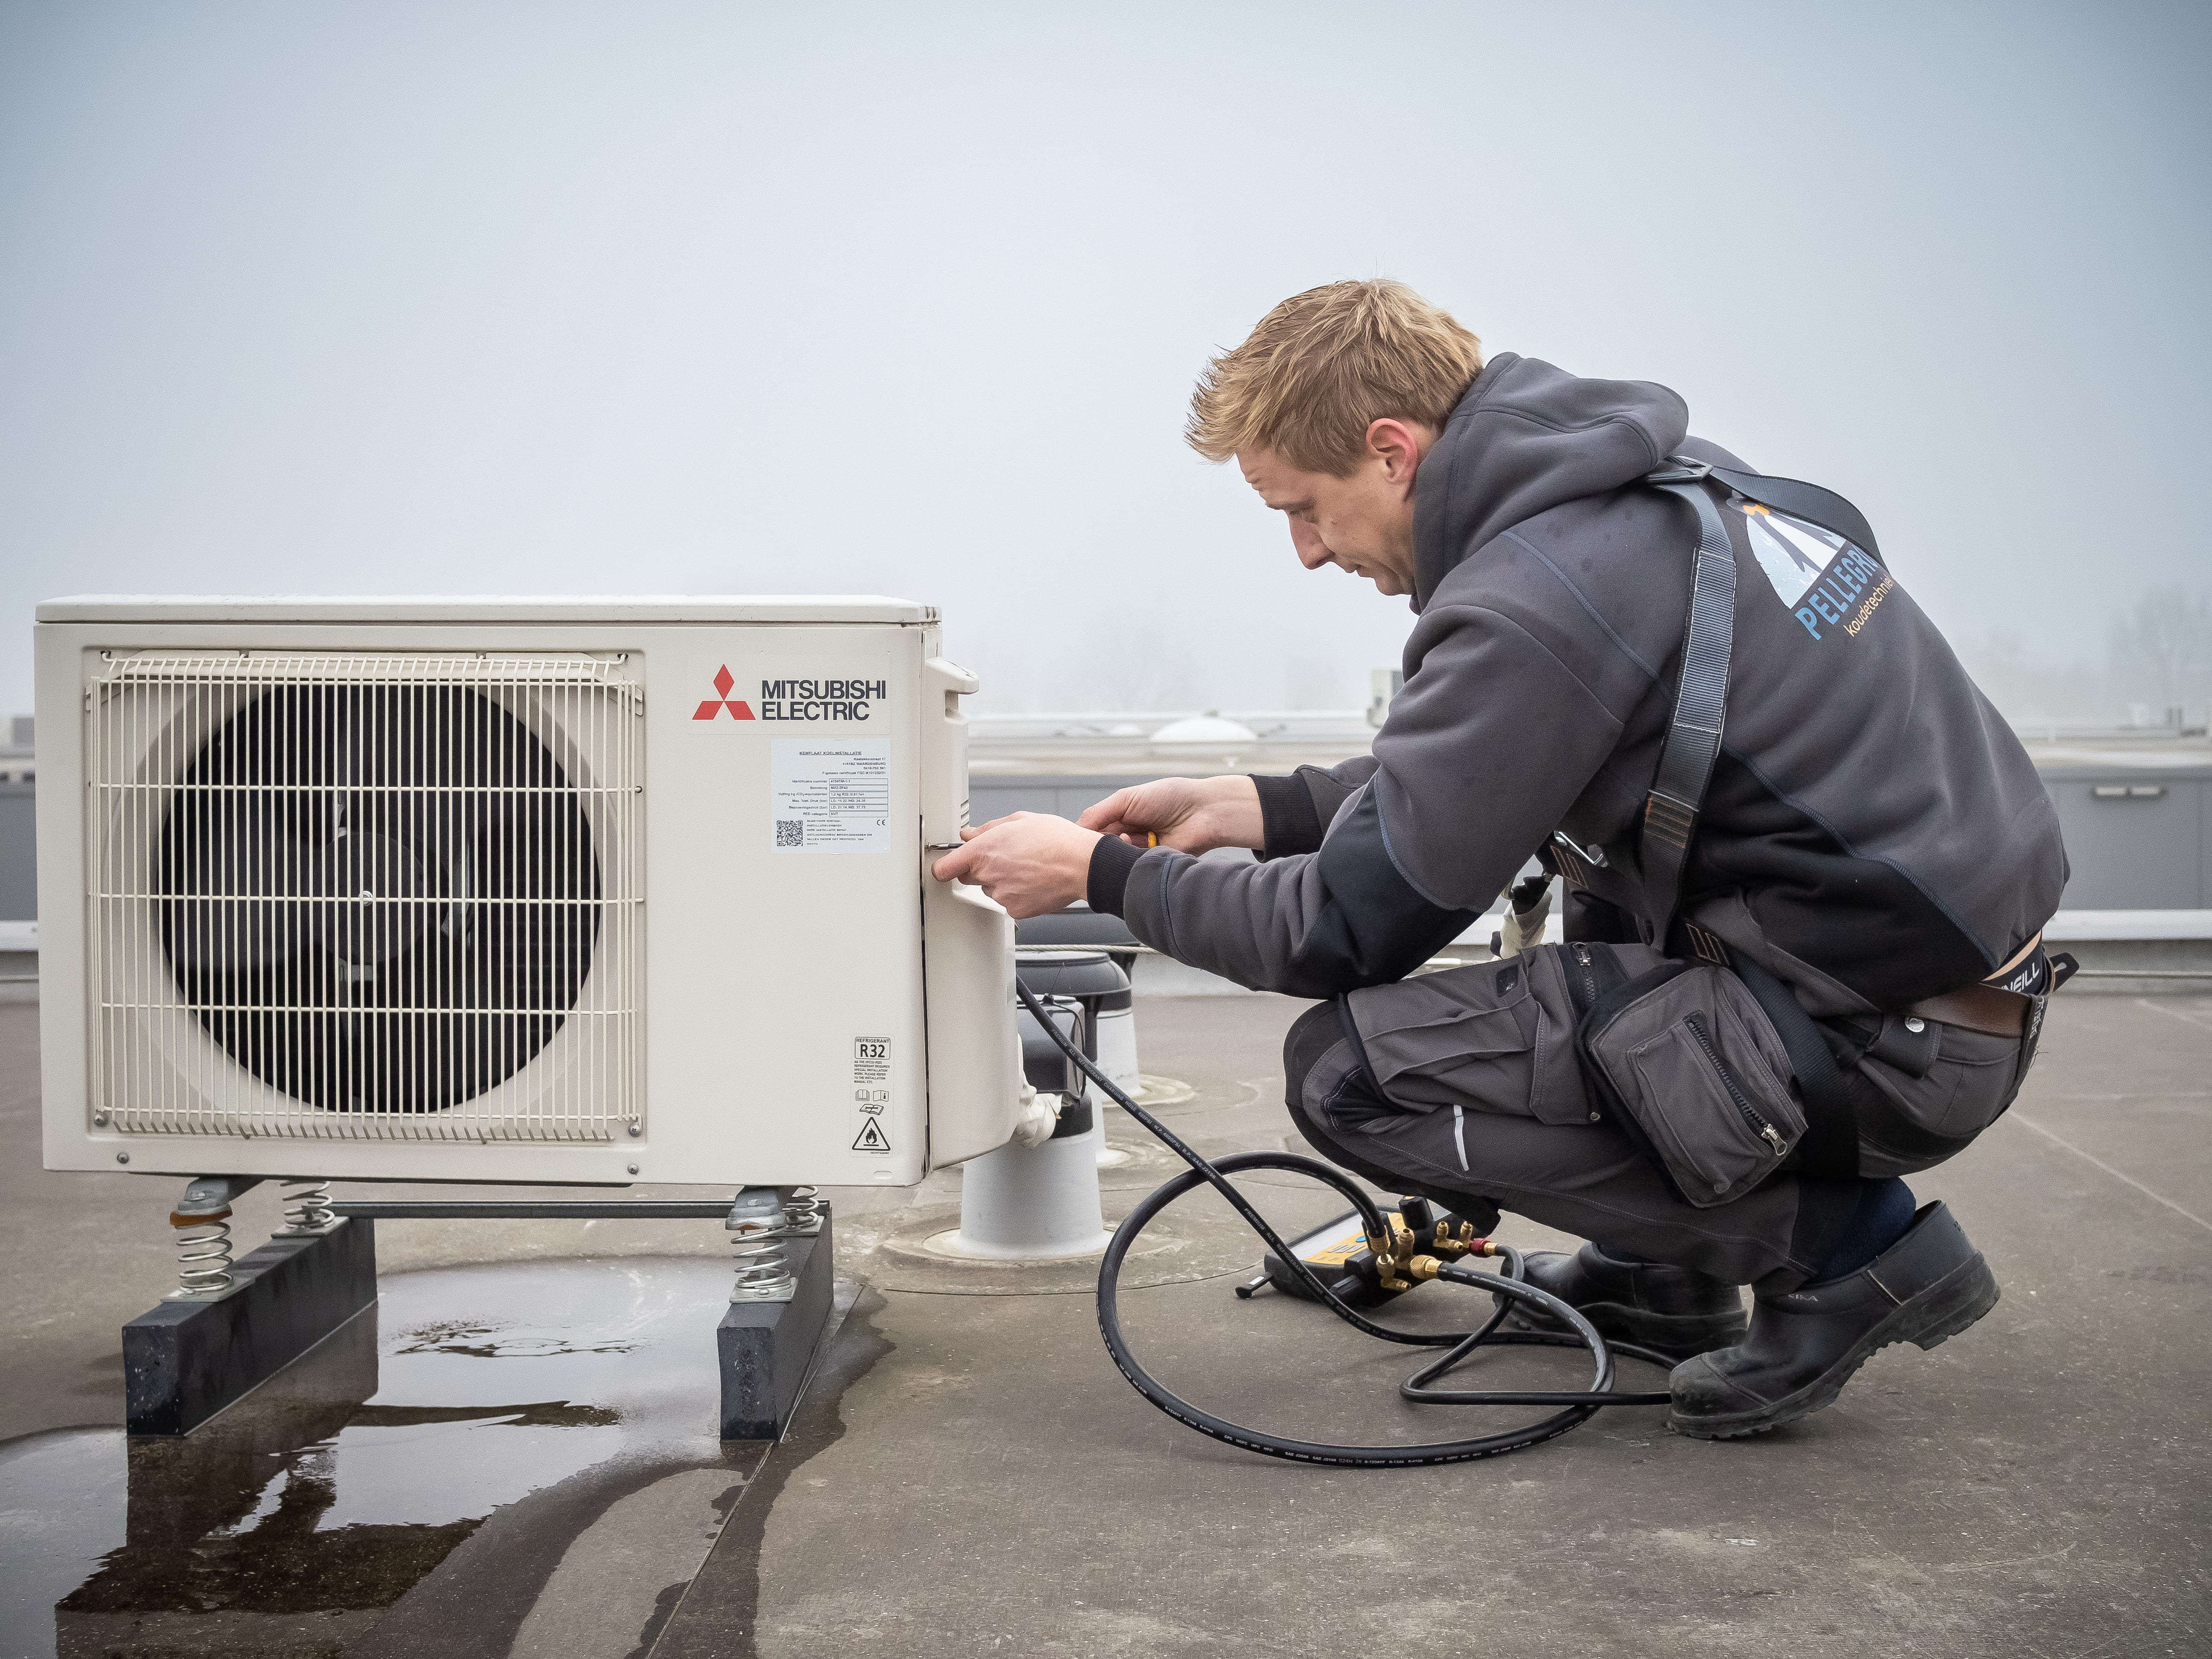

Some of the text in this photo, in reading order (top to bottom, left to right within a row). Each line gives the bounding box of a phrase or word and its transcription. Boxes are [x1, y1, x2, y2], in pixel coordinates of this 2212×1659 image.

[762, 680, 886, 700] MITSUBISHI
[762, 701, 870, 721] ELECTRIC
[860, 1044, 885, 1057] R32
[1051, 1028, 1068, 1047] PREMIUM
[1077, 1057, 1103, 1082] REFRIGERANT
[1103, 1082, 1124, 1100] CHARGING
[1125, 1101, 1137, 1112] HOSE
[1163, 1132, 1181, 1147] 4000PSI
[1193, 1158, 1202, 1167] SAE
[1244, 1208, 1265, 1230] PREMIUM
[1277, 1243, 1304, 1273] REFRIGERANT
[1304, 1275, 1323, 1294] CHARGING
